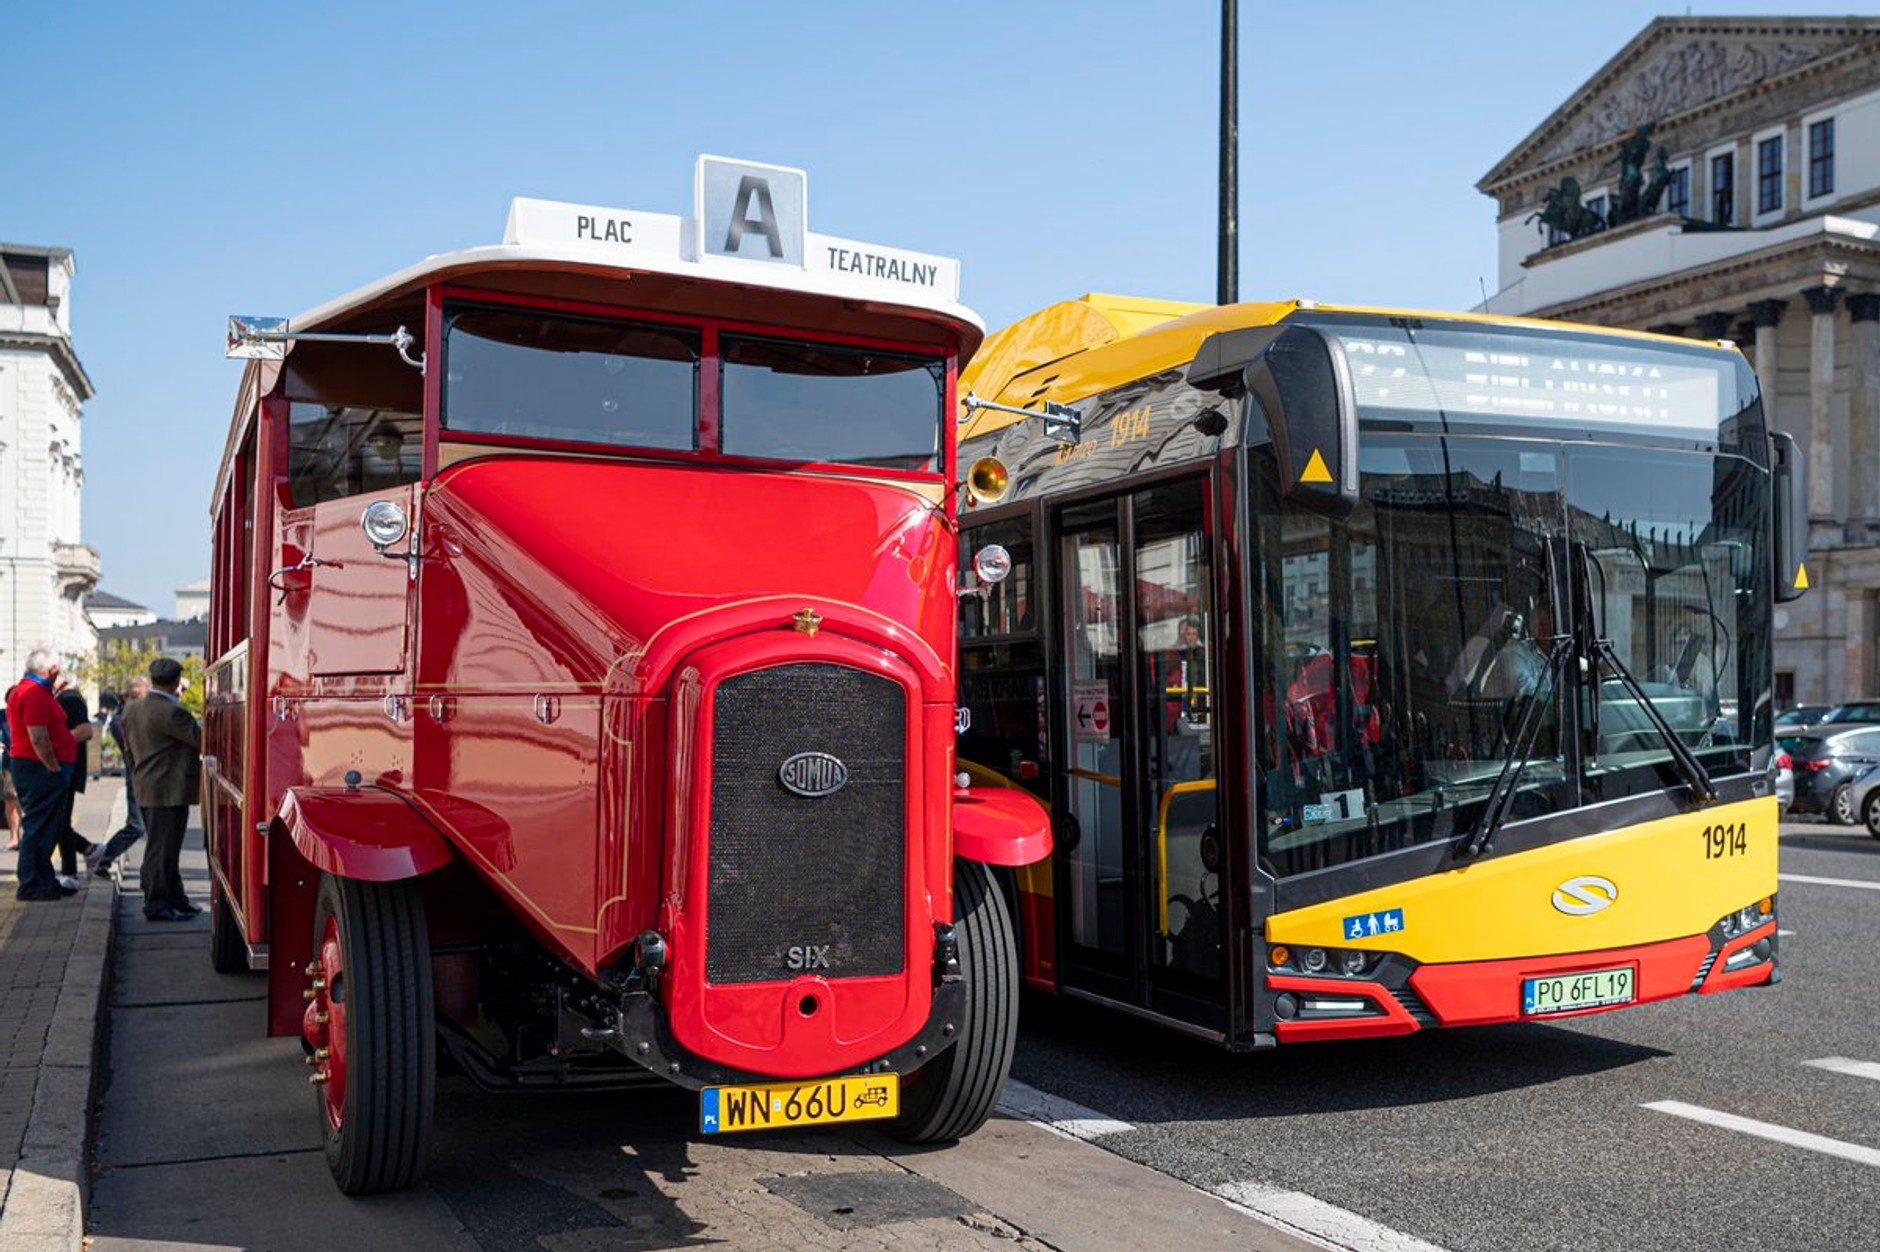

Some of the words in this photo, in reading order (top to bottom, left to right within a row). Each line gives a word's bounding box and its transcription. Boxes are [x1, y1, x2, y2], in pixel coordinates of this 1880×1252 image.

[576, 215, 633, 244] PLAC
[724, 174, 785, 259] A
[827, 247, 938, 287] TEATRALNY
[1111, 404, 1152, 449] 1914
[785, 758, 842, 791] SOMUA
[1333, 793, 1350, 819] 1
[1702, 822, 1747, 860] 1914
[787, 945, 830, 969] SIX
[1538, 980, 1564, 1005] PO
[1570, 972, 1628, 1001] 6FL19
[704, 1115, 717, 1125] PL
[727, 1089, 771, 1127] WN
[784, 1083, 846, 1121] 66U
